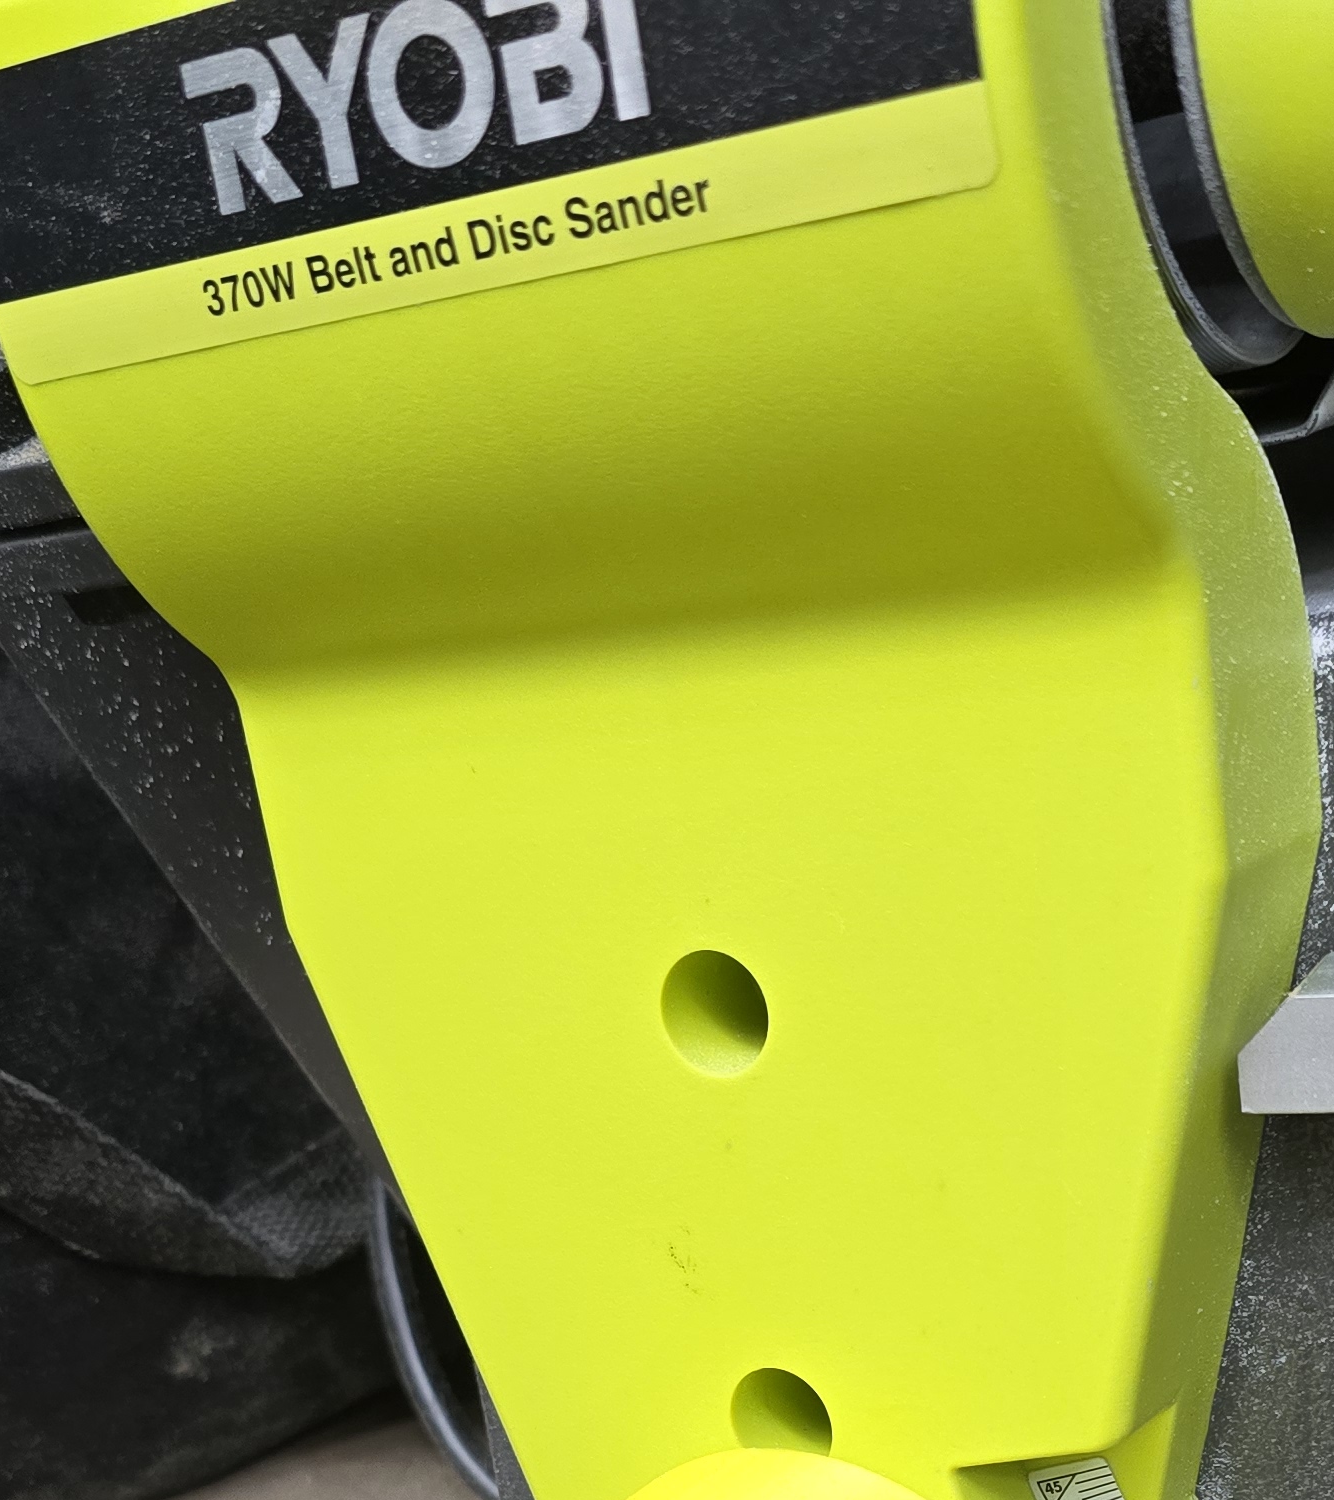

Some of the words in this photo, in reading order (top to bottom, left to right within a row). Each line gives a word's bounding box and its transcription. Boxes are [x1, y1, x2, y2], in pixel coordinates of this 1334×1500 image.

[180, 0, 652, 217] RYOBI
[202, 260, 296, 317] 370W
[307, 245, 383, 295] Belt
[389, 226, 460, 278] and
[467, 213, 555, 261] Disc
[563, 178, 710, 239] Sander
[1044, 1480, 1063, 1496] 45
